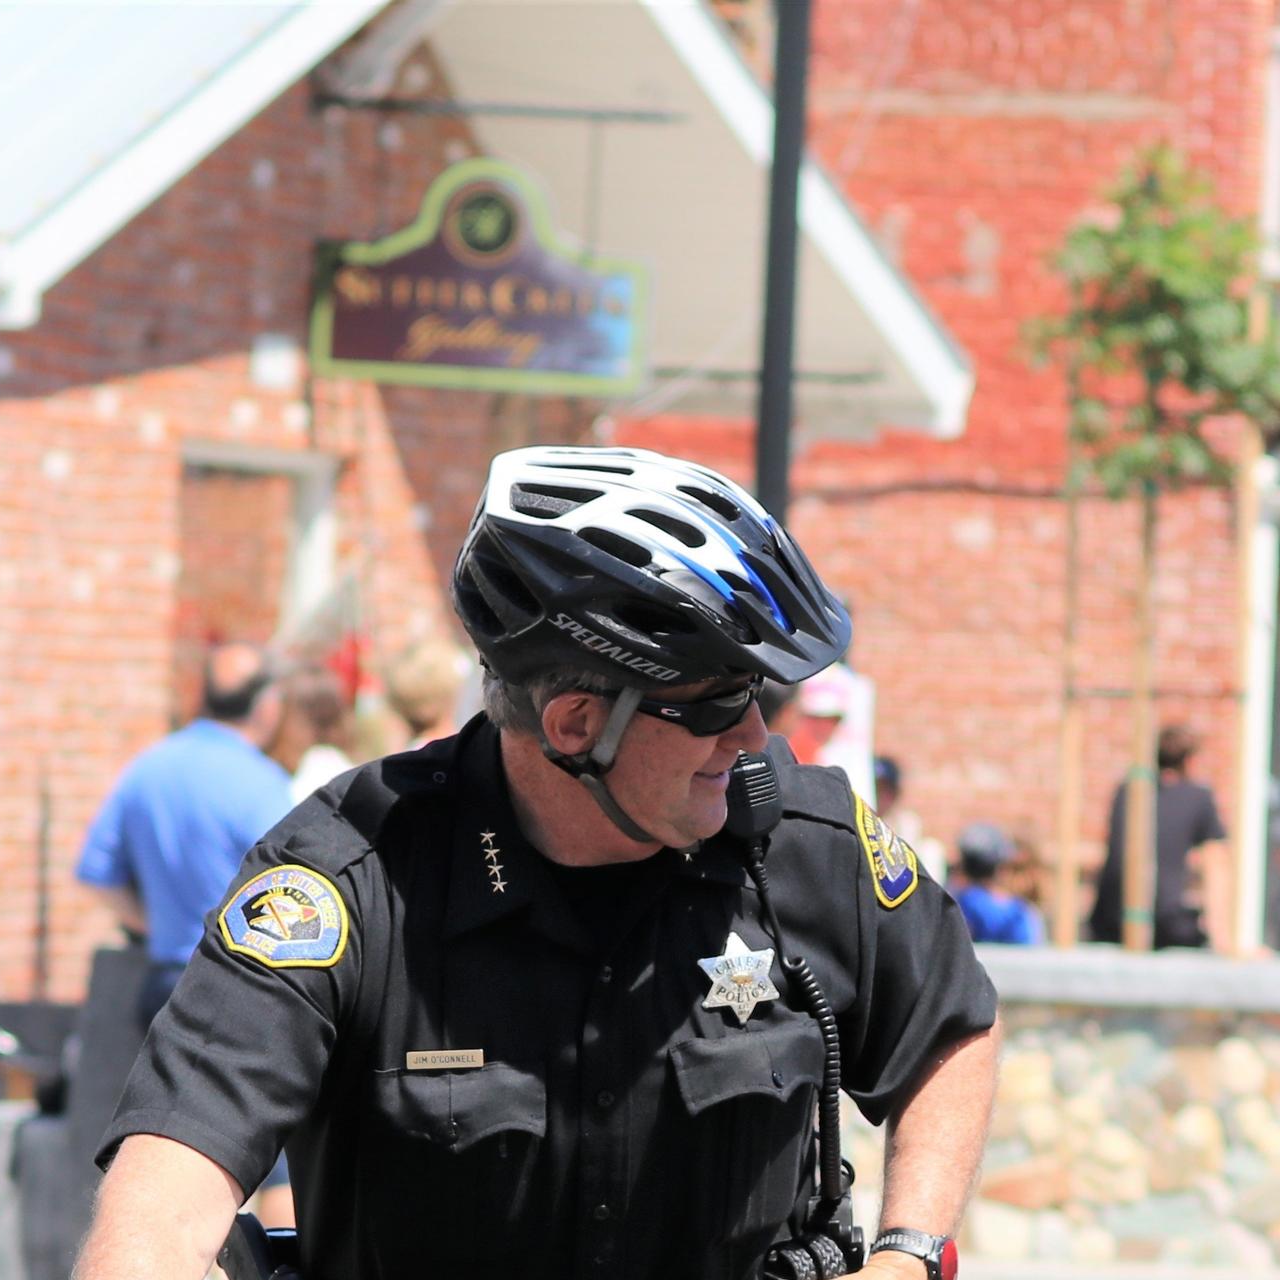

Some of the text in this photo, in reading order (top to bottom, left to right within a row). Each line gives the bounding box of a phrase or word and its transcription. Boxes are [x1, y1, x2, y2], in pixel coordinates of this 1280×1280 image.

[547, 612, 681, 681] SPECIALIZED
[715, 956, 764, 975] CHIEF
[716, 981, 769, 1003] POLICE
[414, 1056, 428, 1065] JIM
